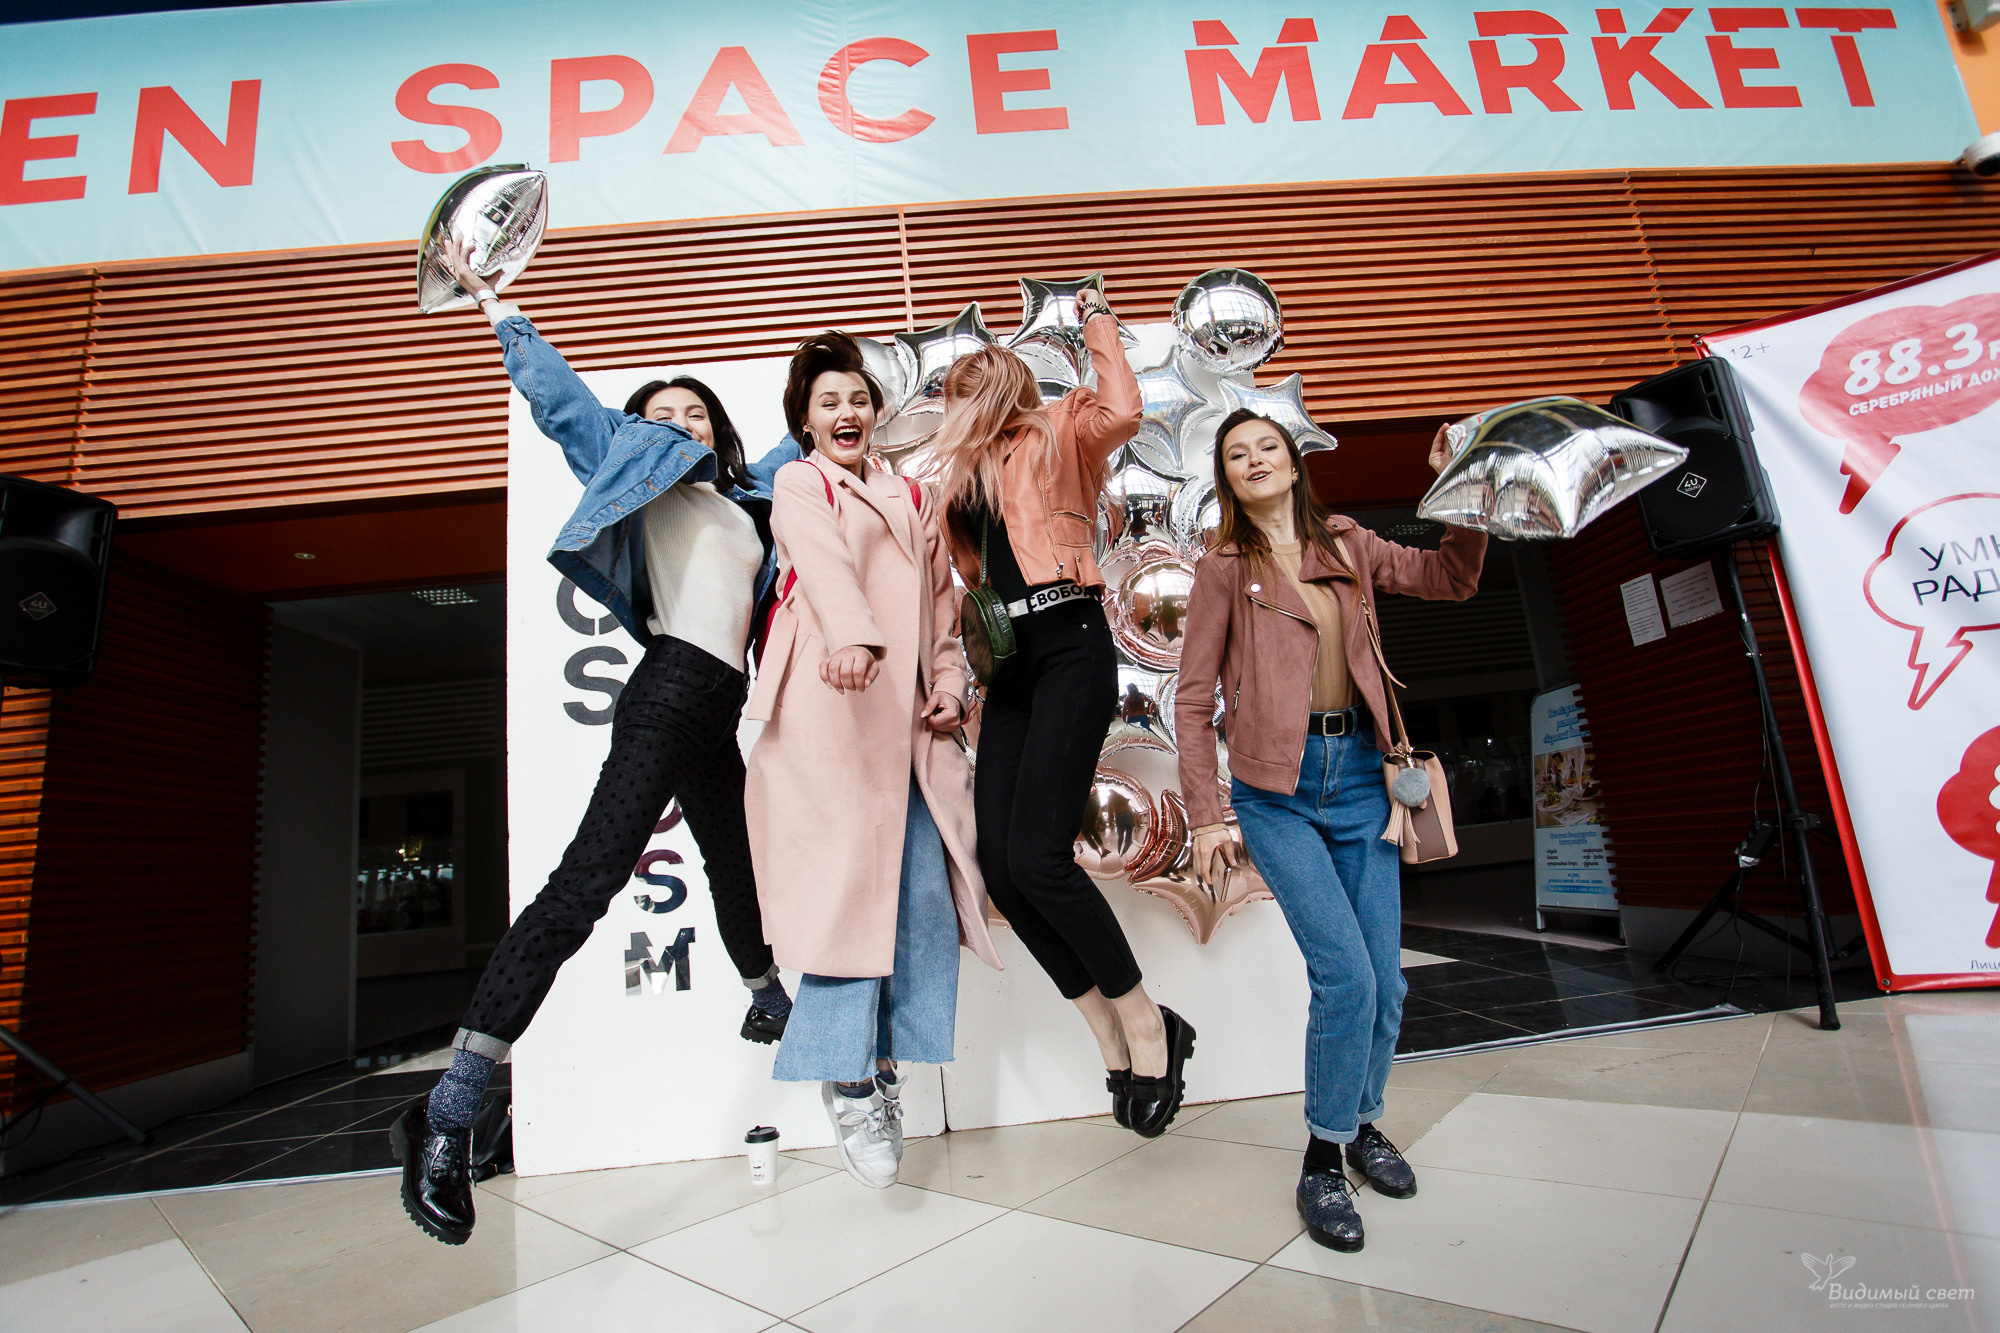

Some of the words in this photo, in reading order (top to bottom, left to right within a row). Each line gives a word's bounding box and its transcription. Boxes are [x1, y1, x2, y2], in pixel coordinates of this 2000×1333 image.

[0, 78, 263, 207] EN
[390, 29, 1070, 175] SPACE
[1184, 7, 1898, 127] MARKET
[1728, 342, 1771, 361] 12+
[1843, 323, 1983, 396] 88.3
[1848, 373, 1963, 416] СЕРЕБРЯНЫЙ
[1685, 478, 1699, 488] 4U
[1970, 959, 2000, 971] Лиц
